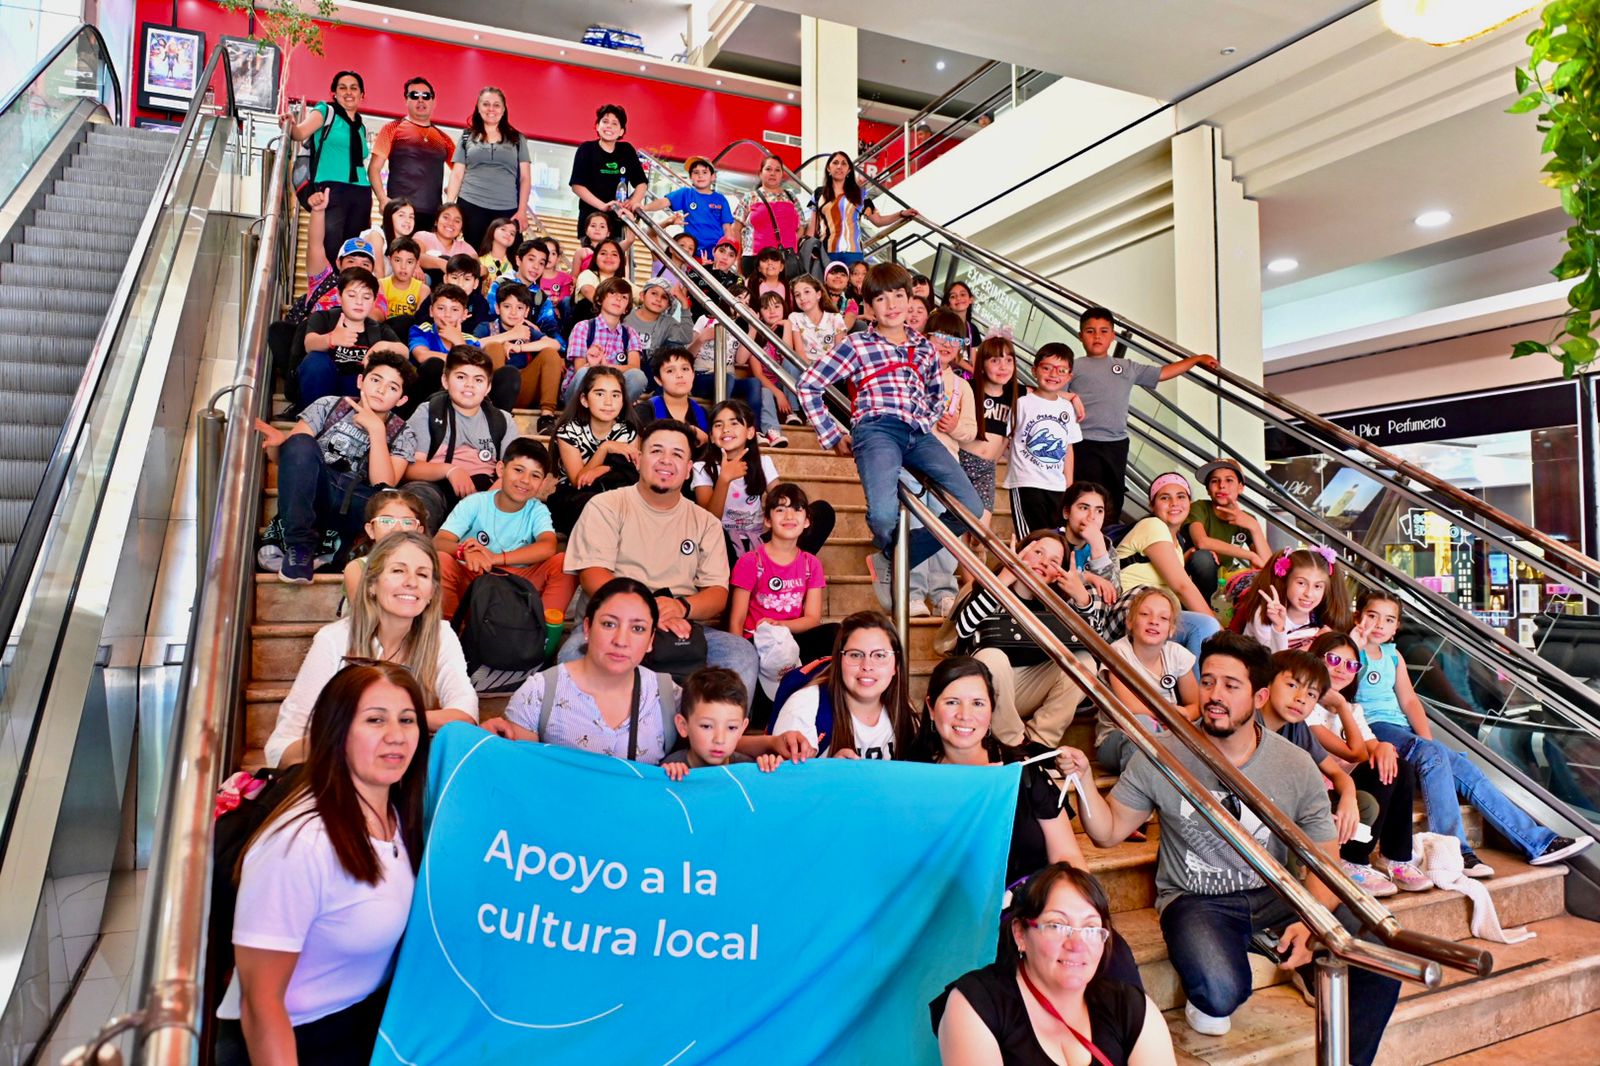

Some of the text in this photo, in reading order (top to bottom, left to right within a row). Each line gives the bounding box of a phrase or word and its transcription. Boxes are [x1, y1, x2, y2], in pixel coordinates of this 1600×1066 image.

[483, 829, 718, 896] Apoyo a la
[477, 903, 759, 961] cultura local
